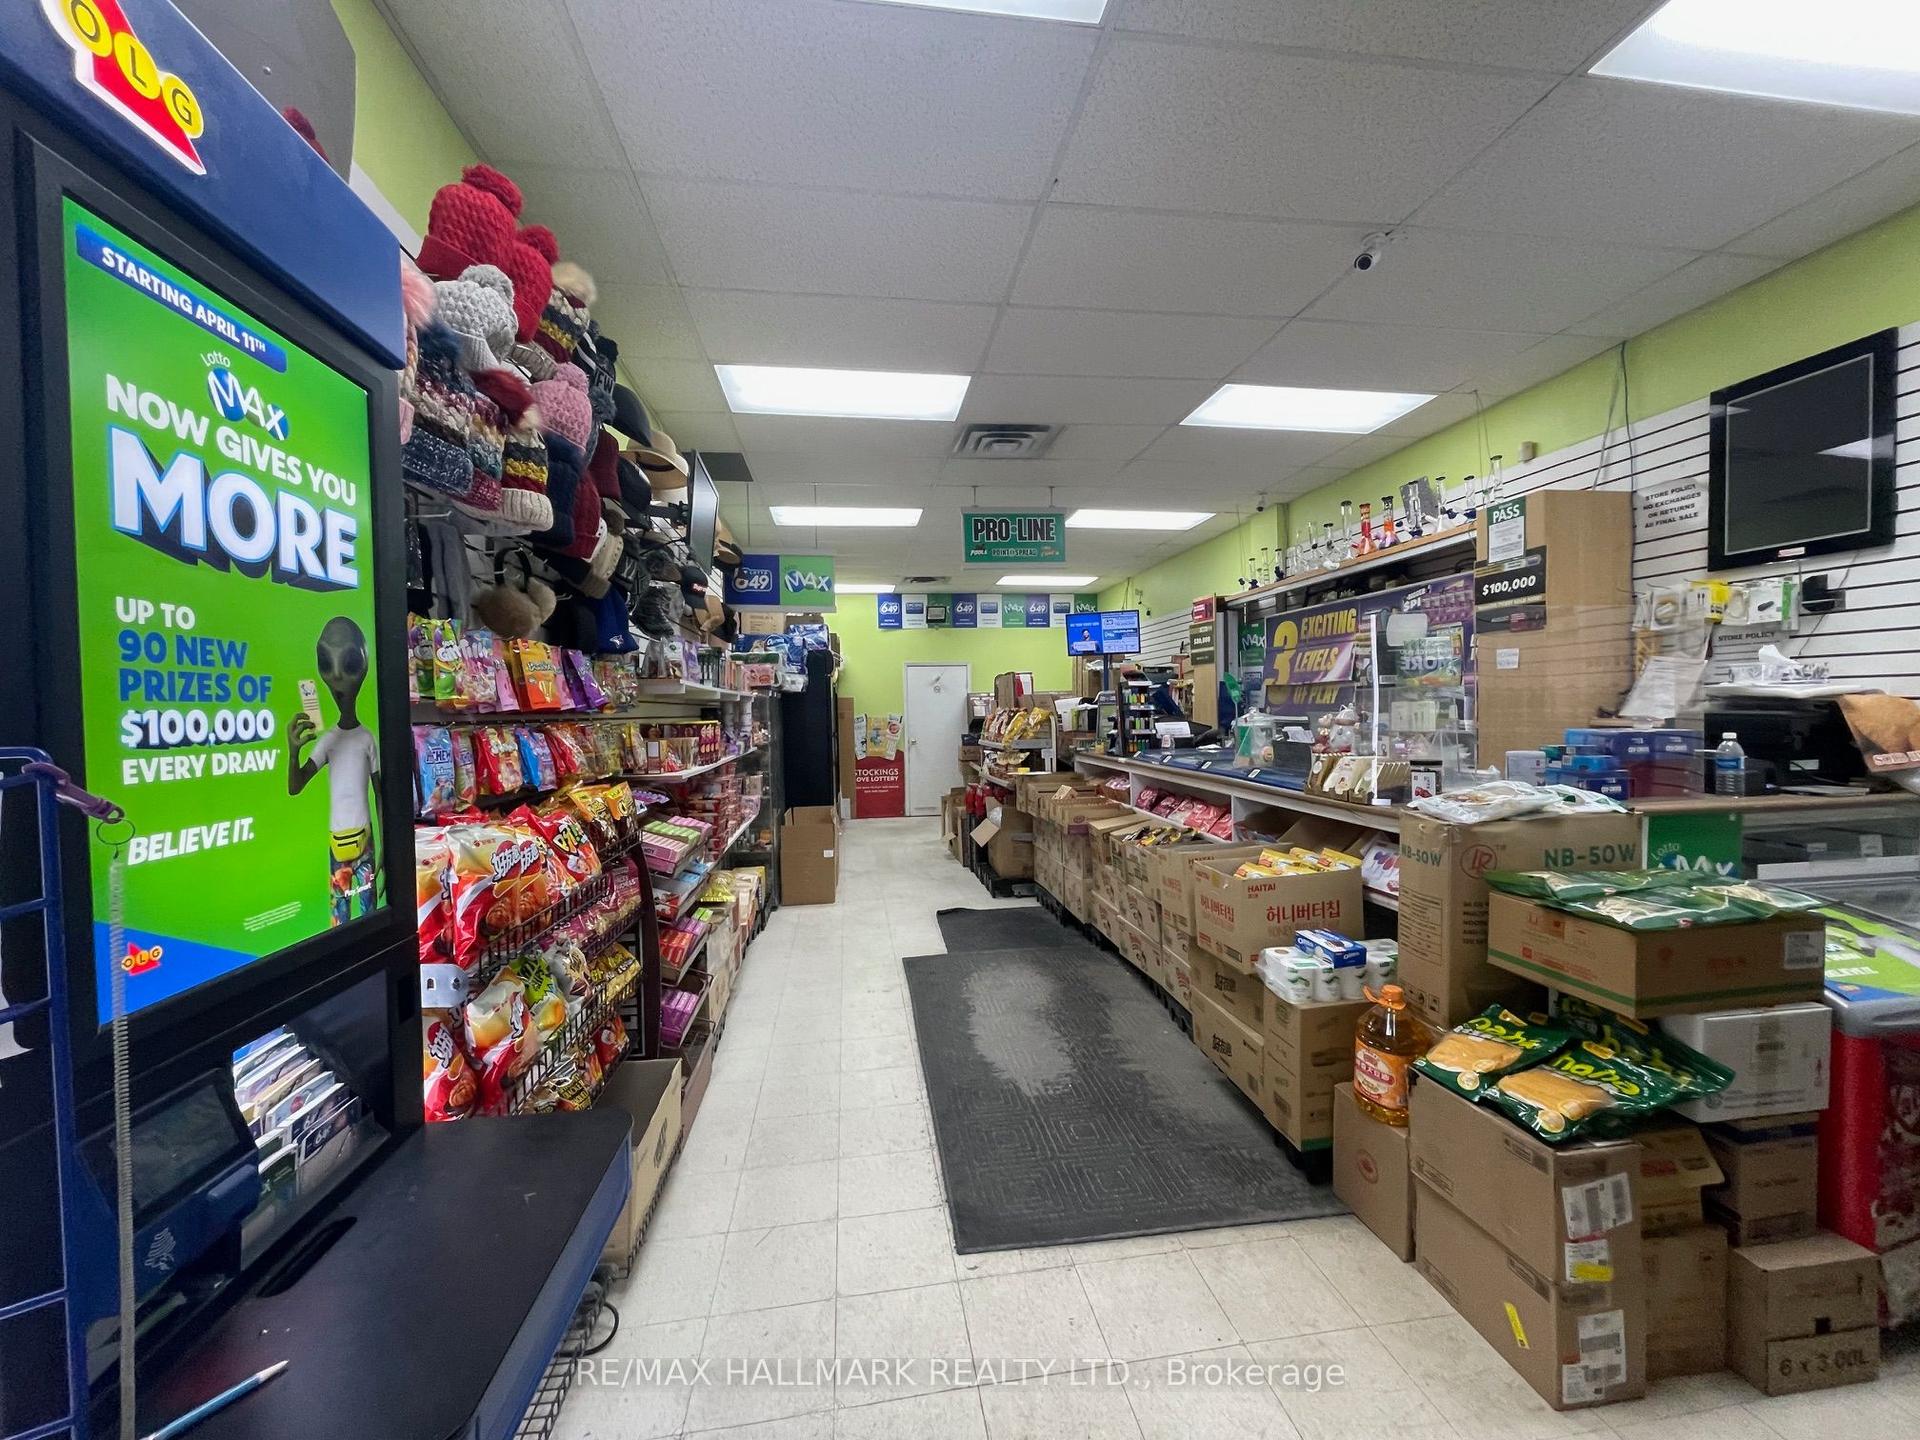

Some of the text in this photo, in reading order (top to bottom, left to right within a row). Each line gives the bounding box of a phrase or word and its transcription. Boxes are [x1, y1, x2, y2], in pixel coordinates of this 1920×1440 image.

[70, 0, 195, 126] OLG
[102, 247, 266, 354] STARTING APRIL 11TH
[106, 373, 358, 506] NOW GIVES YOU
[109, 425, 359, 588] MORE
[1645, 490, 1669, 501] STORE
[1655, 491, 1701, 508] EXCHANGES
[1493, 505, 1520, 524] PASS
[1656, 517, 1677, 526] FINAL
[1679, 512, 1699, 521] SALE
[1660, 503, 1695, 516] RETURNS
[785, 571, 830, 593] MAX
[1482, 575, 1537, 597] $100,000
[115, 596, 196, 630] UP TO
[1301, 608, 1357, 640] EXCITING
[118, 629, 249, 669] 90 NEW
[1718, 631, 1775, 642] STORE POLICY
[1294, 647, 1338, 672] LEVELS
[118, 667, 273, 703] PRIZES OF
[121, 708, 275, 749] $100,000
[122, 754, 206, 786] EVERY
[128, 817, 255, 866] BELIEVE IT.
[1651, 842, 1680, 861] Lotto
[1544, 843, 1636, 867] NB-50W
[1248, 883, 1276, 893] HAITAI
[1266, 900, 1341, 924] 허니버터칩
[122, 947, 163, 972] OLG
